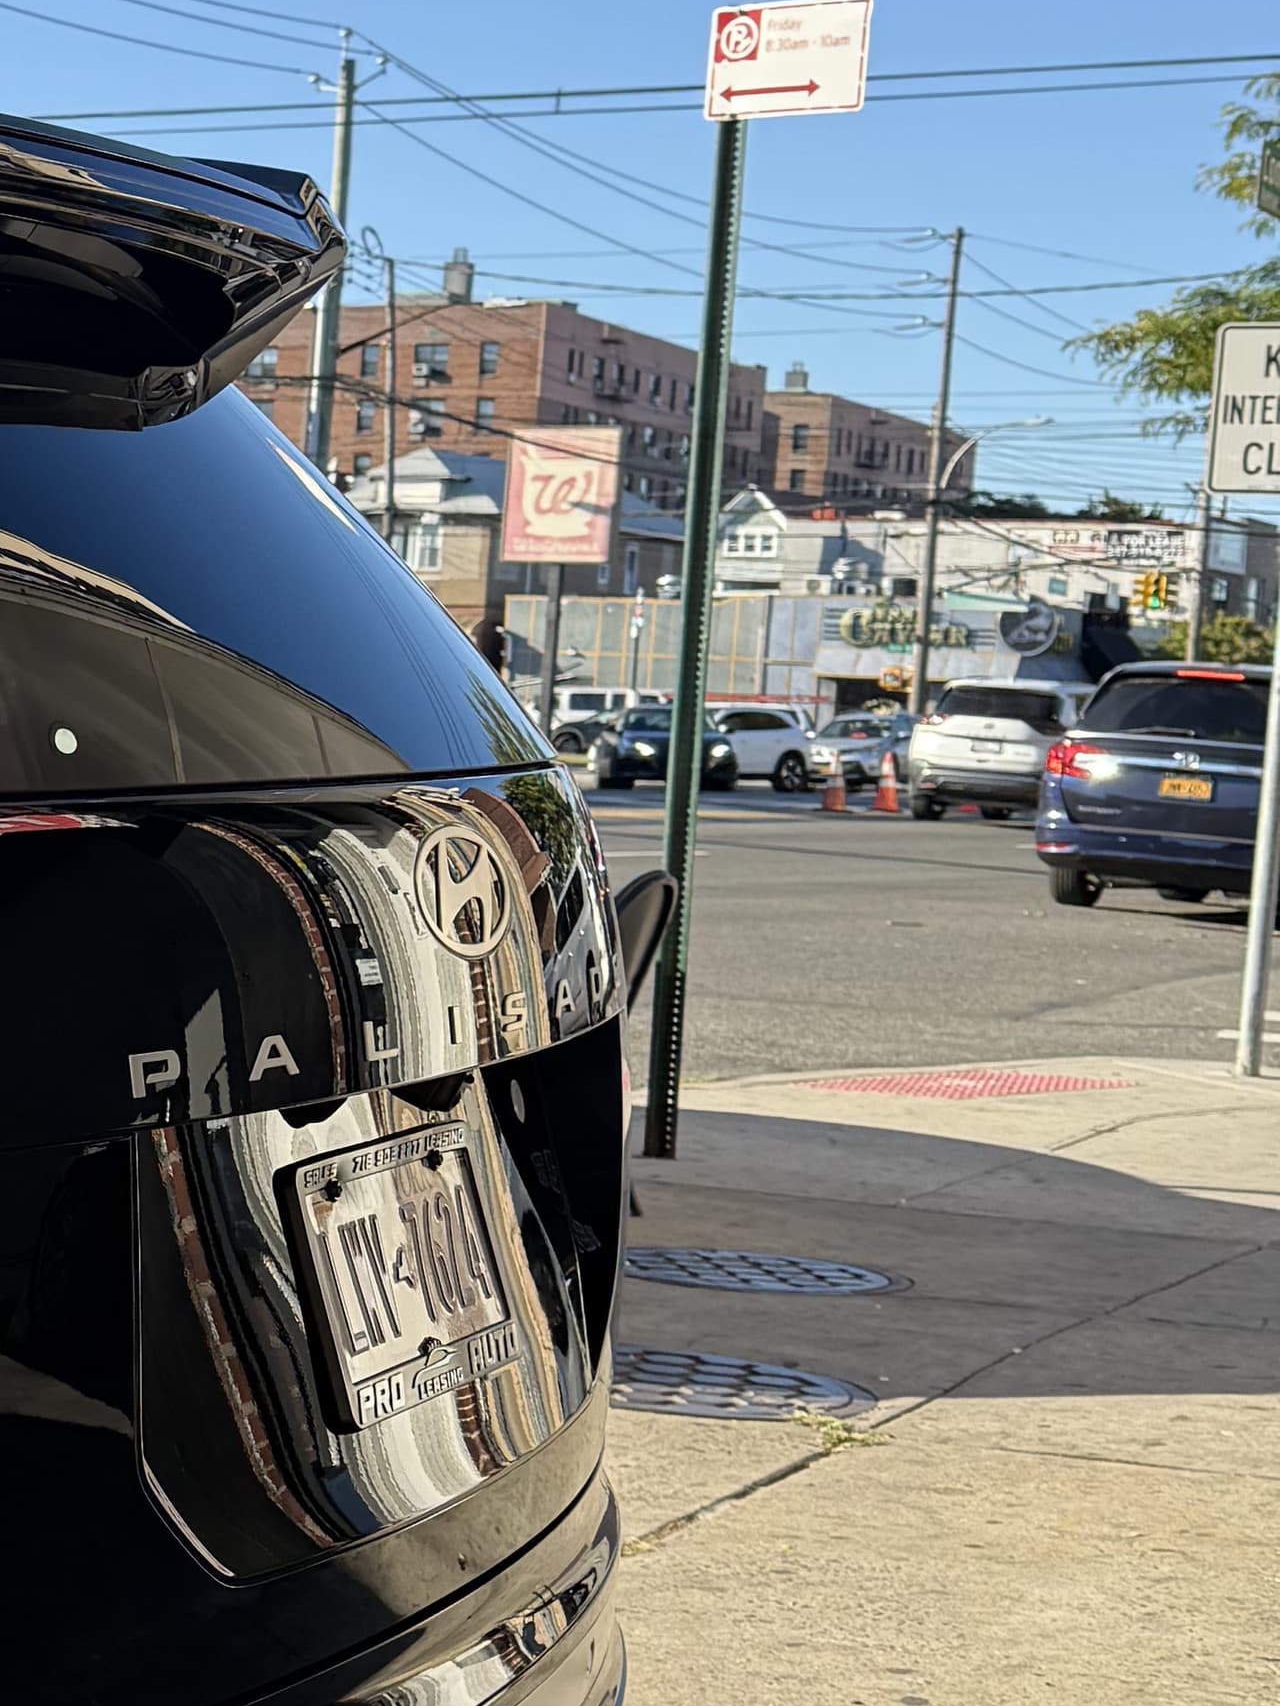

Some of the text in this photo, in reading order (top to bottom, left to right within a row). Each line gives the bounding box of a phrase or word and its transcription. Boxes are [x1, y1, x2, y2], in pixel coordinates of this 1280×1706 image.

[1222, 394, 1280, 425] INTE
[128, 953, 619, 1099] PALISAD
[357, 1323, 520, 1425] PRO AUTO
